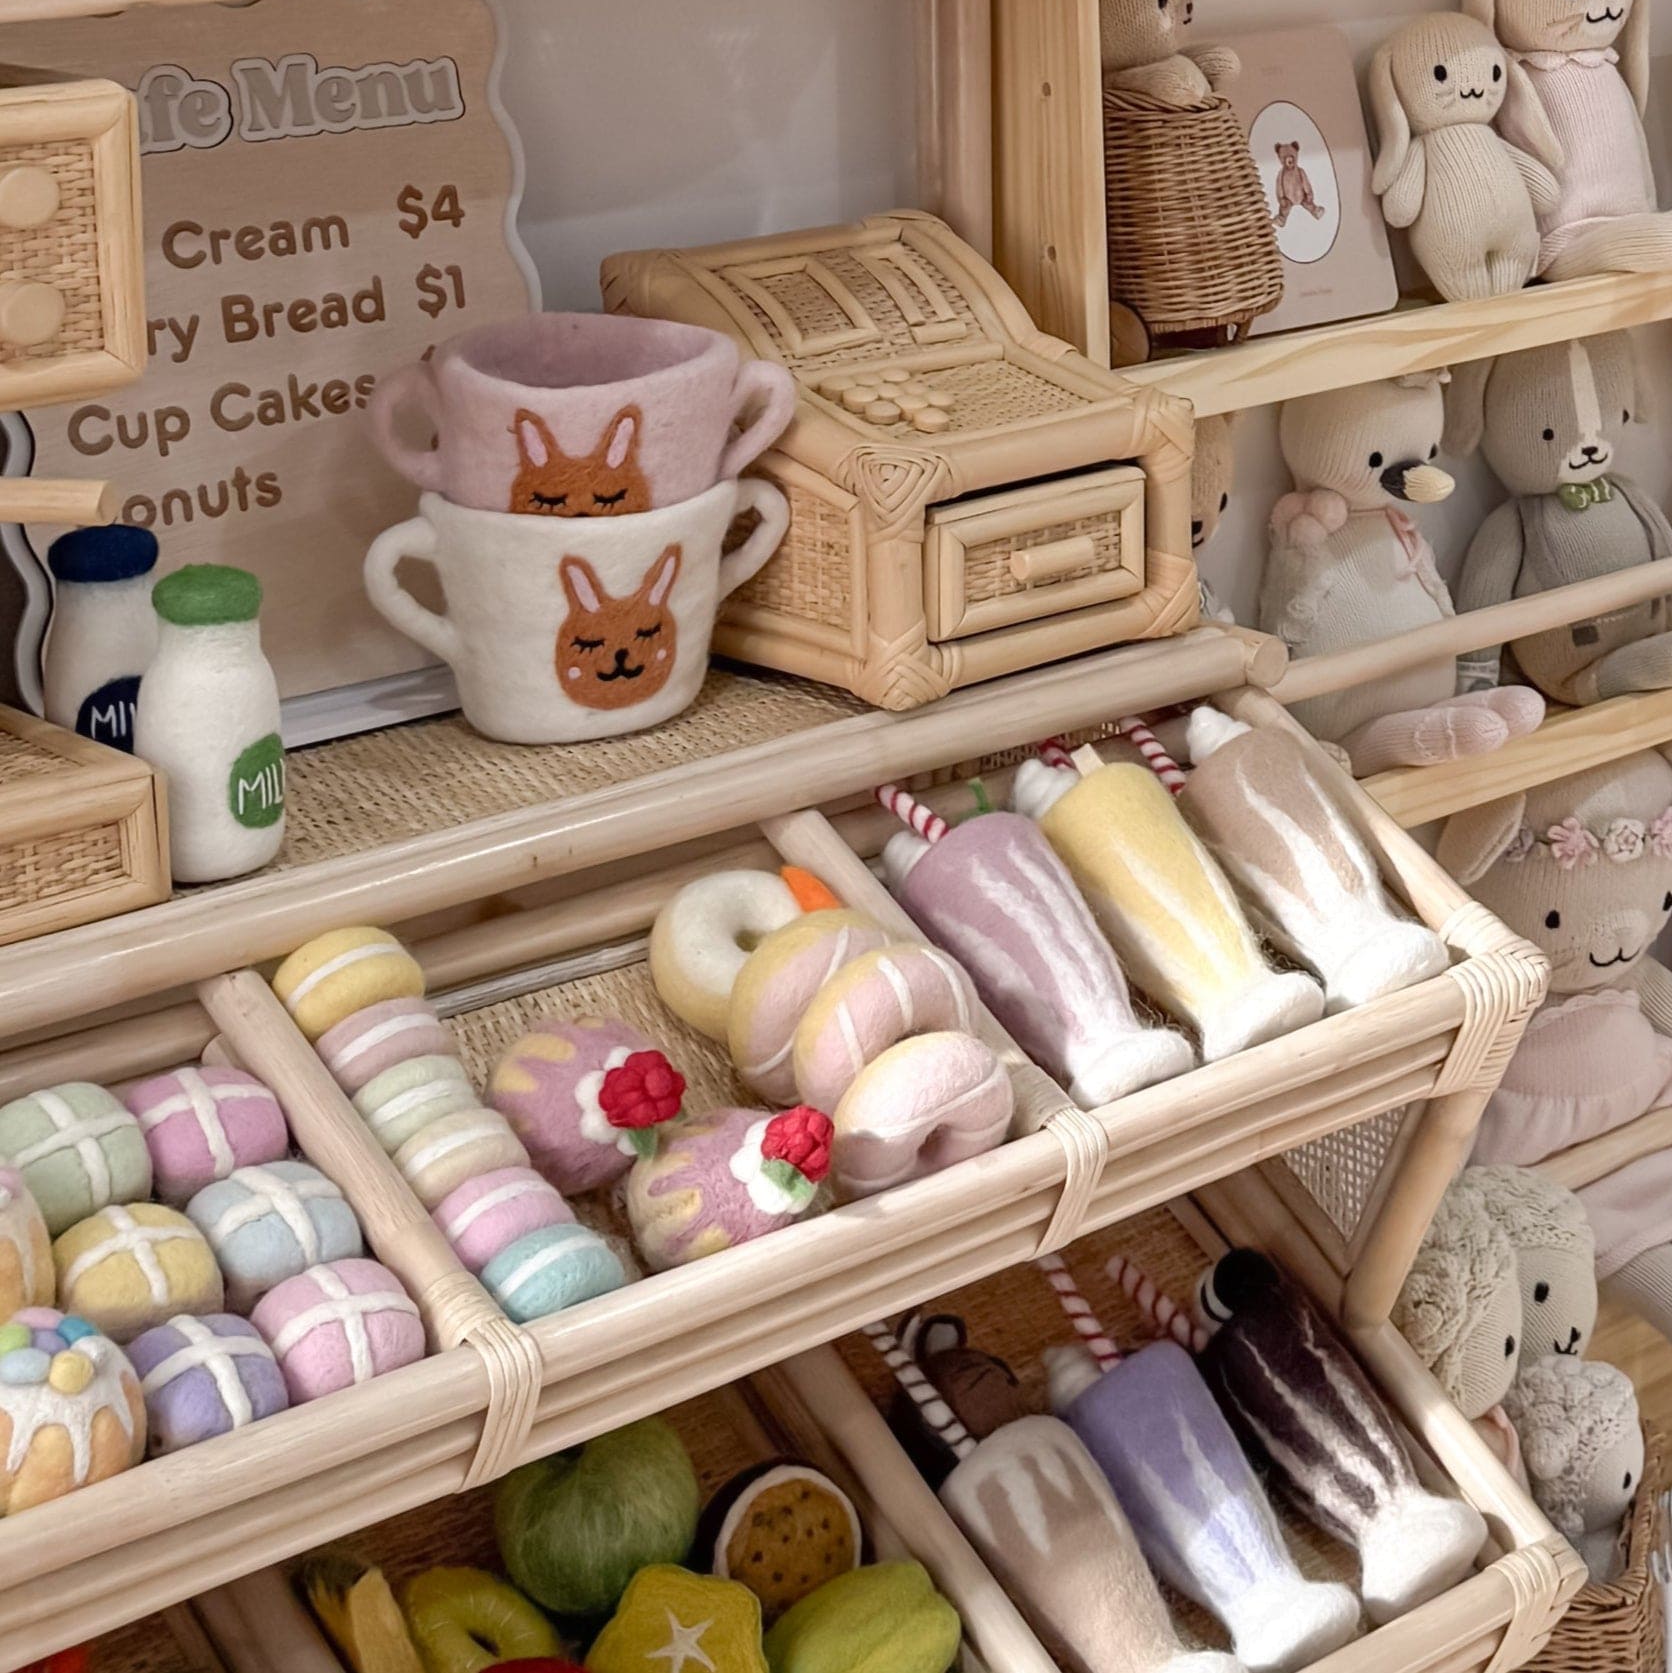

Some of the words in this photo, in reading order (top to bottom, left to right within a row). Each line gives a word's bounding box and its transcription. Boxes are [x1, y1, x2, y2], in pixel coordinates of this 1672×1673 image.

[139, 71, 225, 145] fe
[238, 60, 457, 134] Menu
[161, 214, 351, 269] Cream
[396, 184, 466, 239] $4
[146, 313, 199, 363] ry
[220, 274, 386, 343] Bread
[415, 263, 466, 319] $1
[67, 404, 191, 457] Cup
[209, 373, 376, 432] Cakes
[122, 466, 283, 528] onuts
